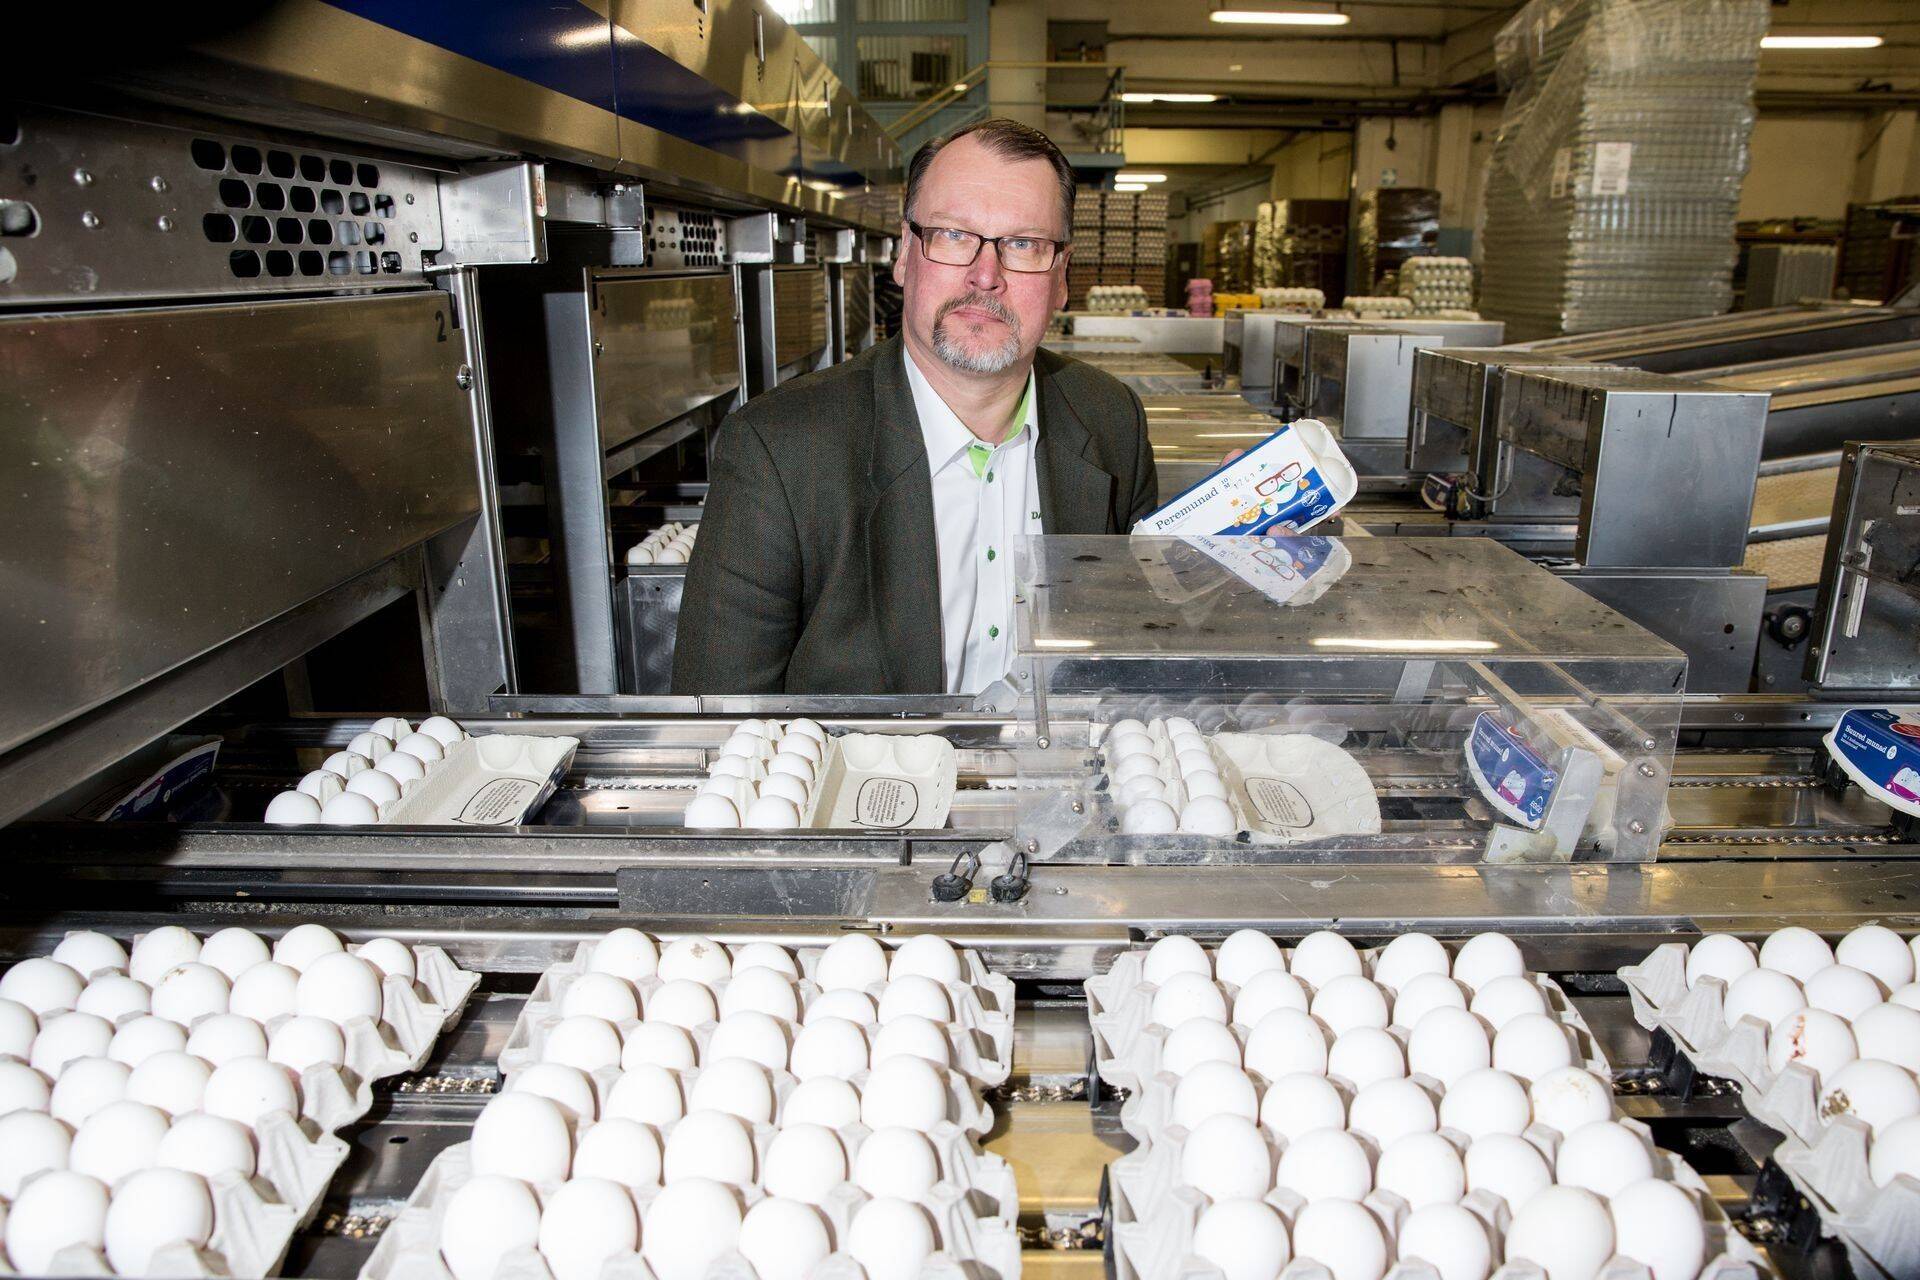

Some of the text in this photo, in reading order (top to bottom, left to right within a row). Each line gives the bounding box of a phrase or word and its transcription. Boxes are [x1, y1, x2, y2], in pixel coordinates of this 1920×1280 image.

[435, 310, 447, 342] 2
[1155, 487, 1220, 530] Peremunad
[1844, 724, 1867, 742] Suured
[1866, 737, 1888, 754] munad
